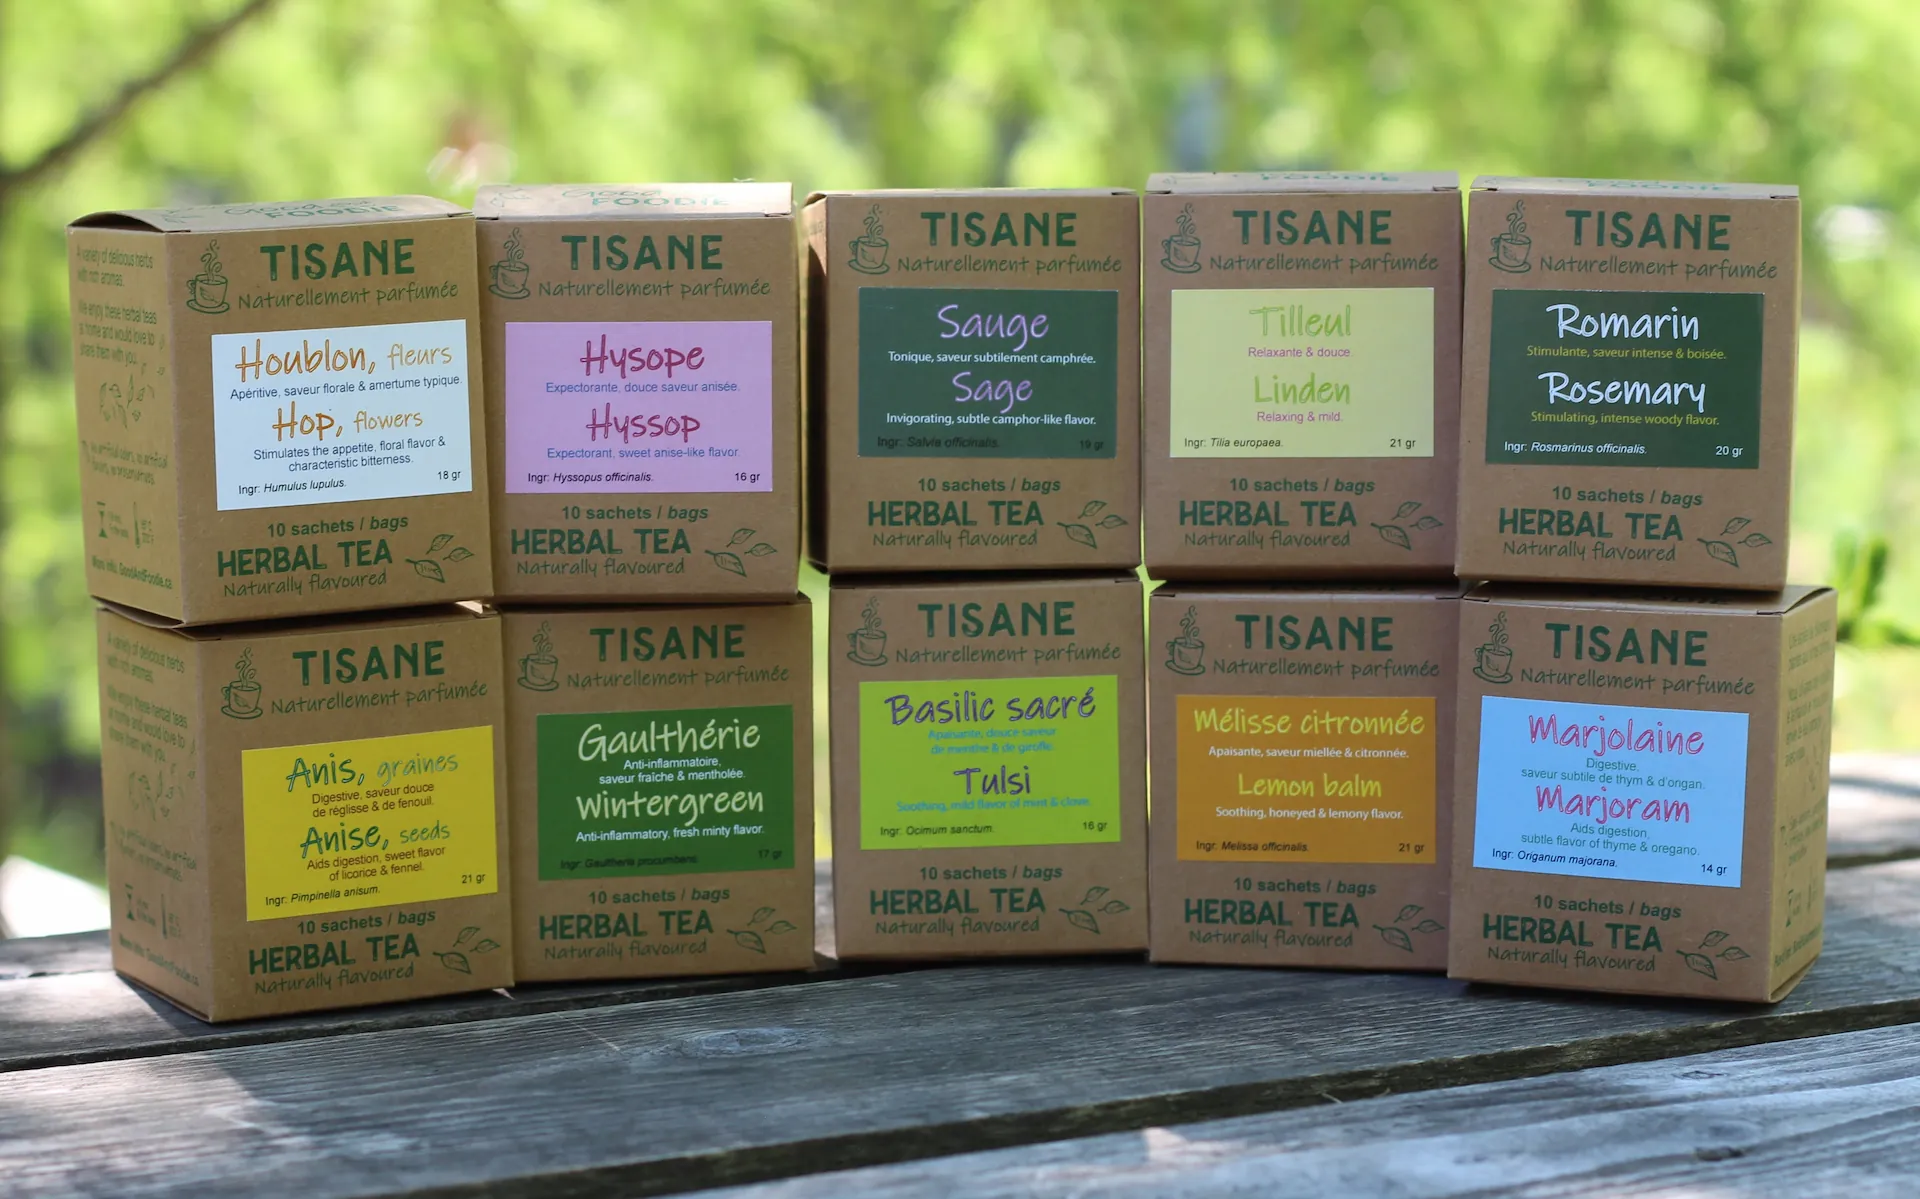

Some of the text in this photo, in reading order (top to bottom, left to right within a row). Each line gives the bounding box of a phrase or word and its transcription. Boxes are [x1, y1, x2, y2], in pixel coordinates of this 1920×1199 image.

[921, 212, 1077, 247] TISANE
[1233, 210, 1392, 245] TISANE
[1565, 210, 1731, 251] TISANE
[260, 239, 415, 281] TISANE
[562, 235, 723, 271] TISANE
[898, 255, 1121, 274] Naturellement parfumée
[1210, 253, 1439, 274] Naturellement parfumée
[1540, 256, 1777, 280] Naturellement parfumée
[239, 282, 458, 309] Naturellement parfumée
[539, 279, 770, 299] Naturellement parfumée
[938, 305, 1048, 351] Sauge
[1250, 305, 1351, 337] Tilleul
[1546, 304, 1699, 340] Romarin
[235, 339, 452, 382] Houblon, fleurs
[580, 334, 704, 379] Hysope
[888, 351, 1096, 365] Tonique, saveur subtilement camphrée.
[1249, 347, 1302, 357] Relaxante
[1306, 347, 1313, 357] &
[230, 375, 463, 400] Apéritive, saveur florale & amertume typique.
[546, 382, 740, 394] Expectorante, douce saveur anisée.
[952, 372, 1032, 413] Sage
[1254, 372, 1350, 404] Linden
[1538, 372, 1705, 413] Rosemary
[272, 401, 423, 441] Hop, flowers
[586, 403, 700, 444] Hyssop
[887, 414, 1096, 426] Invigorating, subtle camphor-like flavor.
[1257, 412, 1343, 424] Relaxing & mild.
[1531, 411, 1719, 427] Stimulating, intense woody flavor.
[1390, 439, 1416, 449] 21 gr
[1531, 442, 1593, 453] Rosmarinus
[1716, 446, 1743, 458] 20 gr
[264, 481, 307, 493] Humulus
[310, 479, 346, 492] lupulus.
[438, 470, 461, 480] 18 gr
[553, 472, 601, 483] Hyssopus
[868, 501, 1044, 526] HERBAL TEA
[1179, 501, 1357, 527] HERBAL TEA
[1499, 508, 1683, 541] HERBAL TEA
[511, 529, 691, 554] HERBAL TEA
[218, 539, 392, 577] HERBAL TEA
[918, 601, 1075, 638] TISANE
[1235, 615, 1393, 651] TISANE
[590, 625, 745, 662] TISANE
[896, 643, 1121, 664] Naturellement parfumée
[1545, 623, 1707, 667] TISANE
[293, 640, 444, 686] TISANE
[567, 665, 789, 688] Naturellement parfumée
[1213, 658, 1440, 679] Naturellement parfumée
[1521, 668, 1755, 695] Naturellement parfumée
[271, 680, 488, 714] Naturellement parfumée
[885, 687, 1095, 725] Basilic sacré
[1194, 708, 1425, 735] Mélisse citronnée
[578, 719, 760, 762] Gaulthérie
[1529, 714, 1704, 757] Marjolaine
[287, 753, 458, 792] Anis, graines
[954, 766, 1030, 795] Tulsi
[1238, 773, 1382, 797] Lemon balm
[312, 783, 434, 805] Digestive, saveur douce
[1536, 785, 1690, 824] Marjoram
[576, 790, 764, 827] Wintergreen
[1216, 807, 1403, 821] Soothing, honeyed & lemony flavor.
[300, 820, 450, 859] Anise, seeds
[576, 824, 764, 842] Anti-inflammatory, fresh minty flavor.
[907, 826, 947, 836] Ocimum
[1083, 821, 1107, 831] 16 gr
[1518, 850, 1566, 864] Origanum
[1569, 855, 1617, 868] majorana.
[1701, 864, 1727, 876] 14 gr
[461, 874, 485, 884] 21 gr
[291, 890, 341, 903] Pimpinella
[344, 886, 380, 897] anisum.
[870, 887, 1046, 915] HERBAL TEA
[539, 910, 713, 940] HERBAL TEA
[1184, 899, 1359, 928] HERBAL TEA
[1483, 914, 1663, 952] HERBAL TEA
[249, 933, 419, 975] HERBAL TEA
